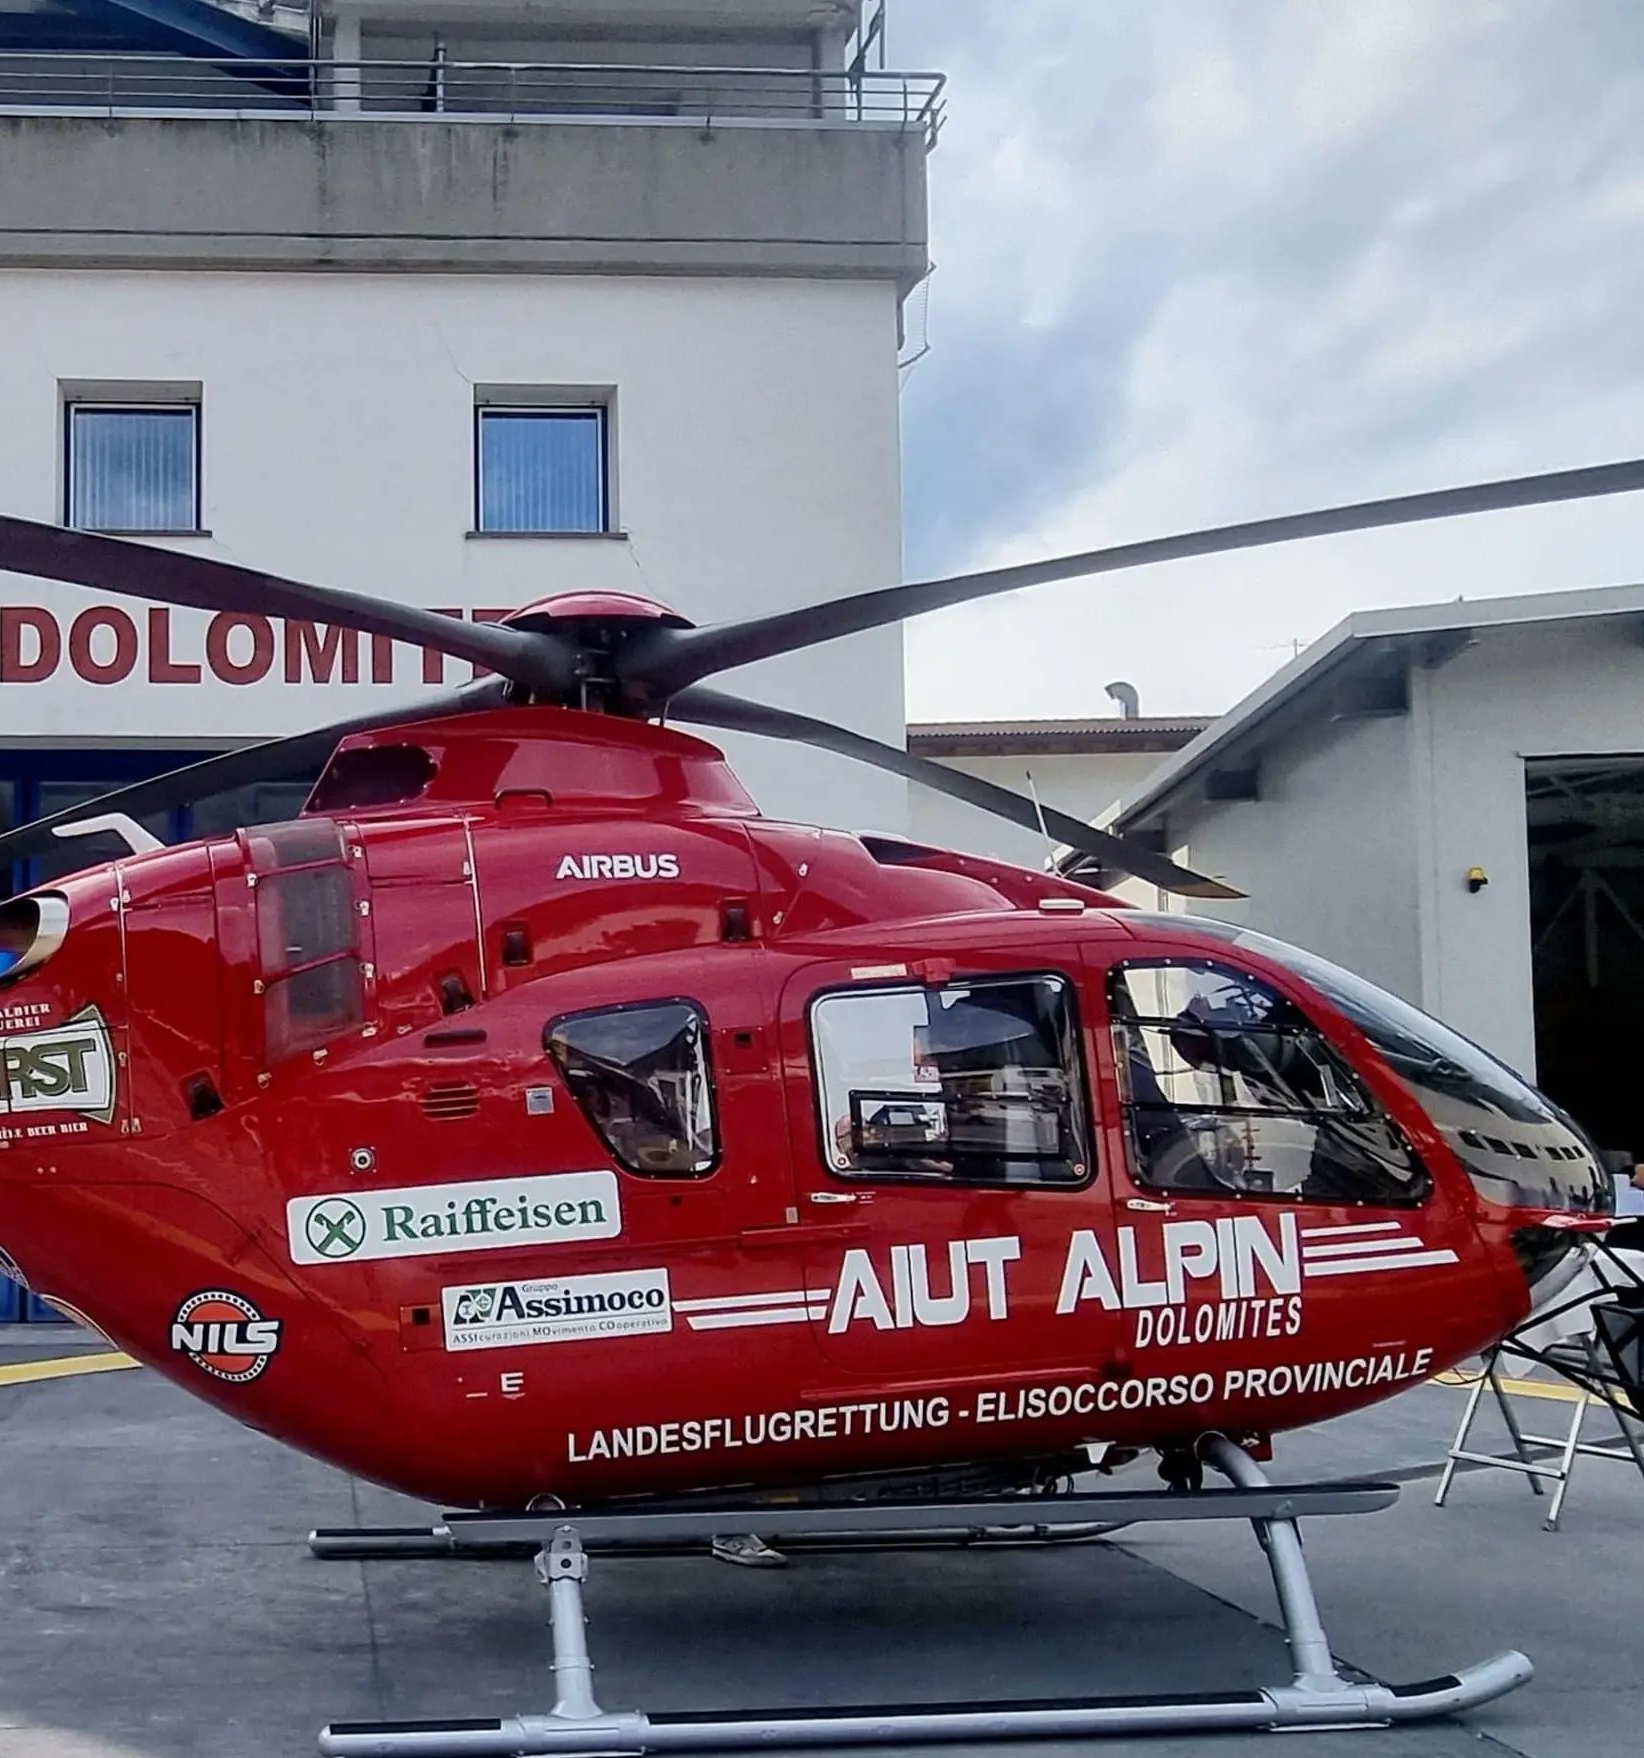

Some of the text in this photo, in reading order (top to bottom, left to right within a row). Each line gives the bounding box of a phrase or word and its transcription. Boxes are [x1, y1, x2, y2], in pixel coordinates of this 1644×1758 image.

[556, 853, 680, 879] AIRBUS
[27, 1122, 56, 1136] BEER
[60, 1121, 88, 1133] BIER
[381, 1195, 607, 1242] Raiffeisen
[521, 1283, 558, 1293] Gruppo
[827, 1212, 1301, 1334] AIUT ALPIN
[496, 1286, 665, 1321] Assimoco
[172, 1320, 279, 1354] NILS
[1134, 1296, 1303, 1349] DOLOMITES
[500, 1371, 524, 1392] E
[567, 1396, 950, 1463] LANDESFLUGRETTUNG
[976, 1372, 1214, 1423] ELISOCCORSO
[1224, 1348, 1434, 1400] PROVINCIALE
